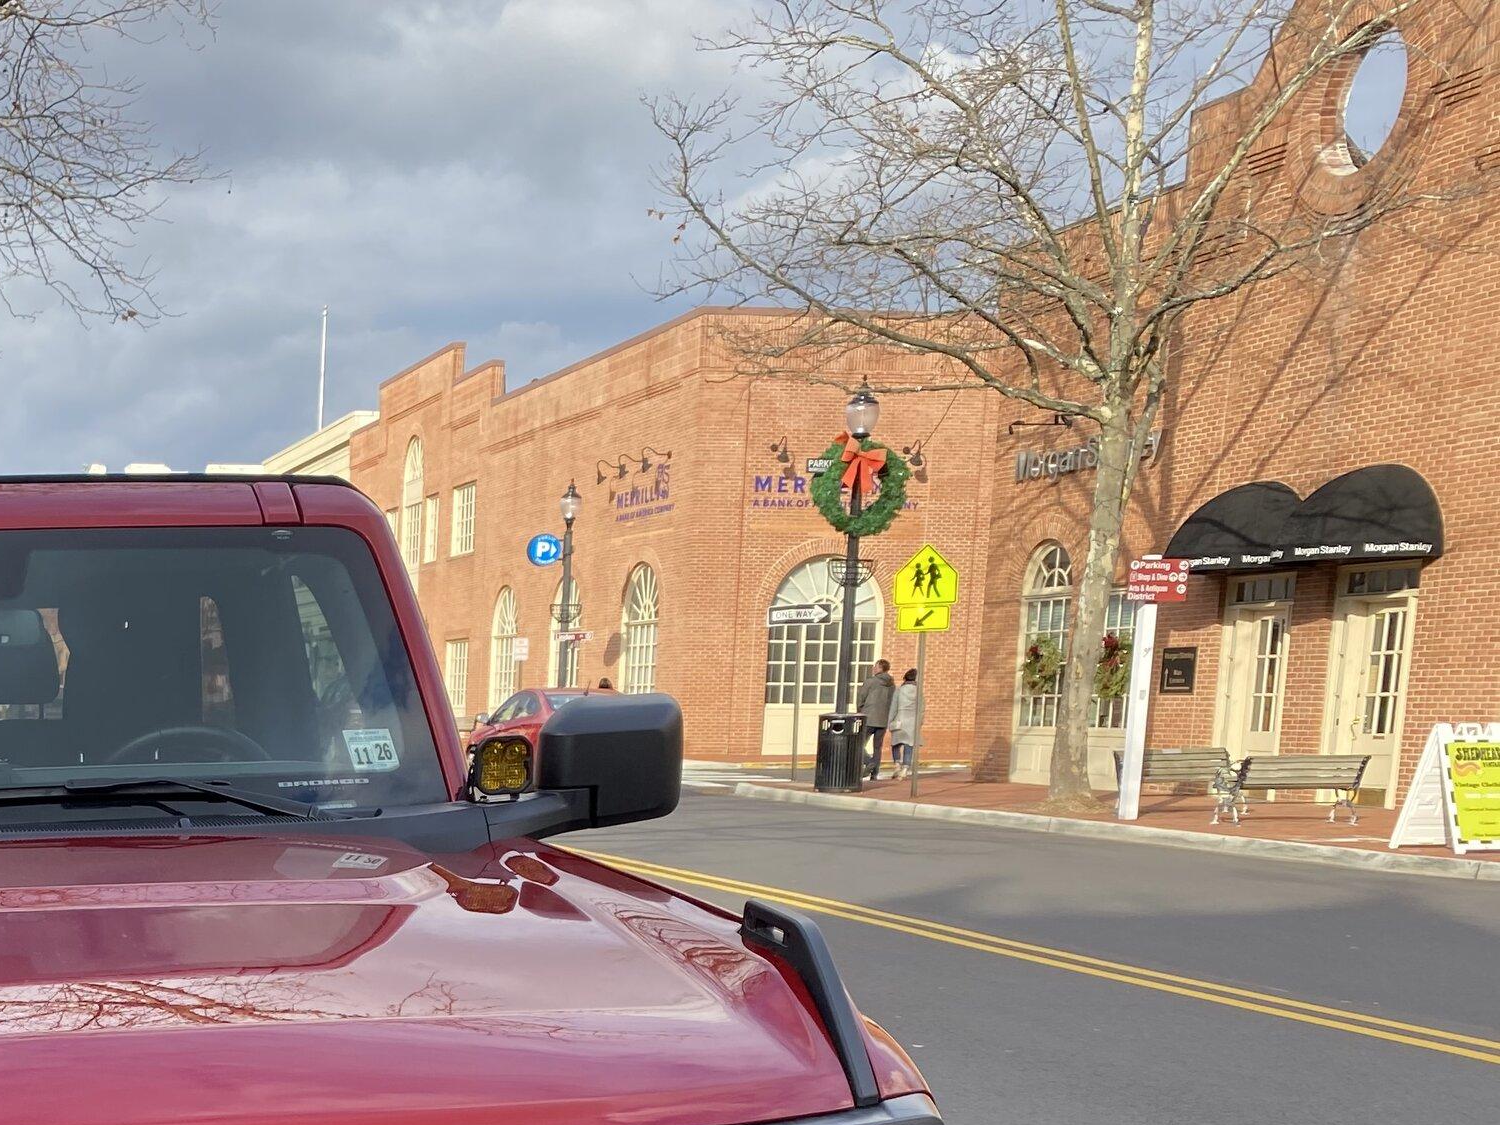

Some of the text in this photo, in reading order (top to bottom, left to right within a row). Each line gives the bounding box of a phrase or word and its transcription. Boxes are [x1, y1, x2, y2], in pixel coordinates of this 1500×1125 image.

[1294, 545, 1351, 557] Morgan Stanley
[1364, 542, 1432, 554] Morgan Stanley
[1203, 557, 1231, 566] Stanley
[1140, 562, 1170, 571] Parking
[1127, 592, 1155, 600] District
[796, 610, 813, 618] WAY
[354, 742, 393, 765] 11 26
[278, 778, 370, 787] BRONCO
